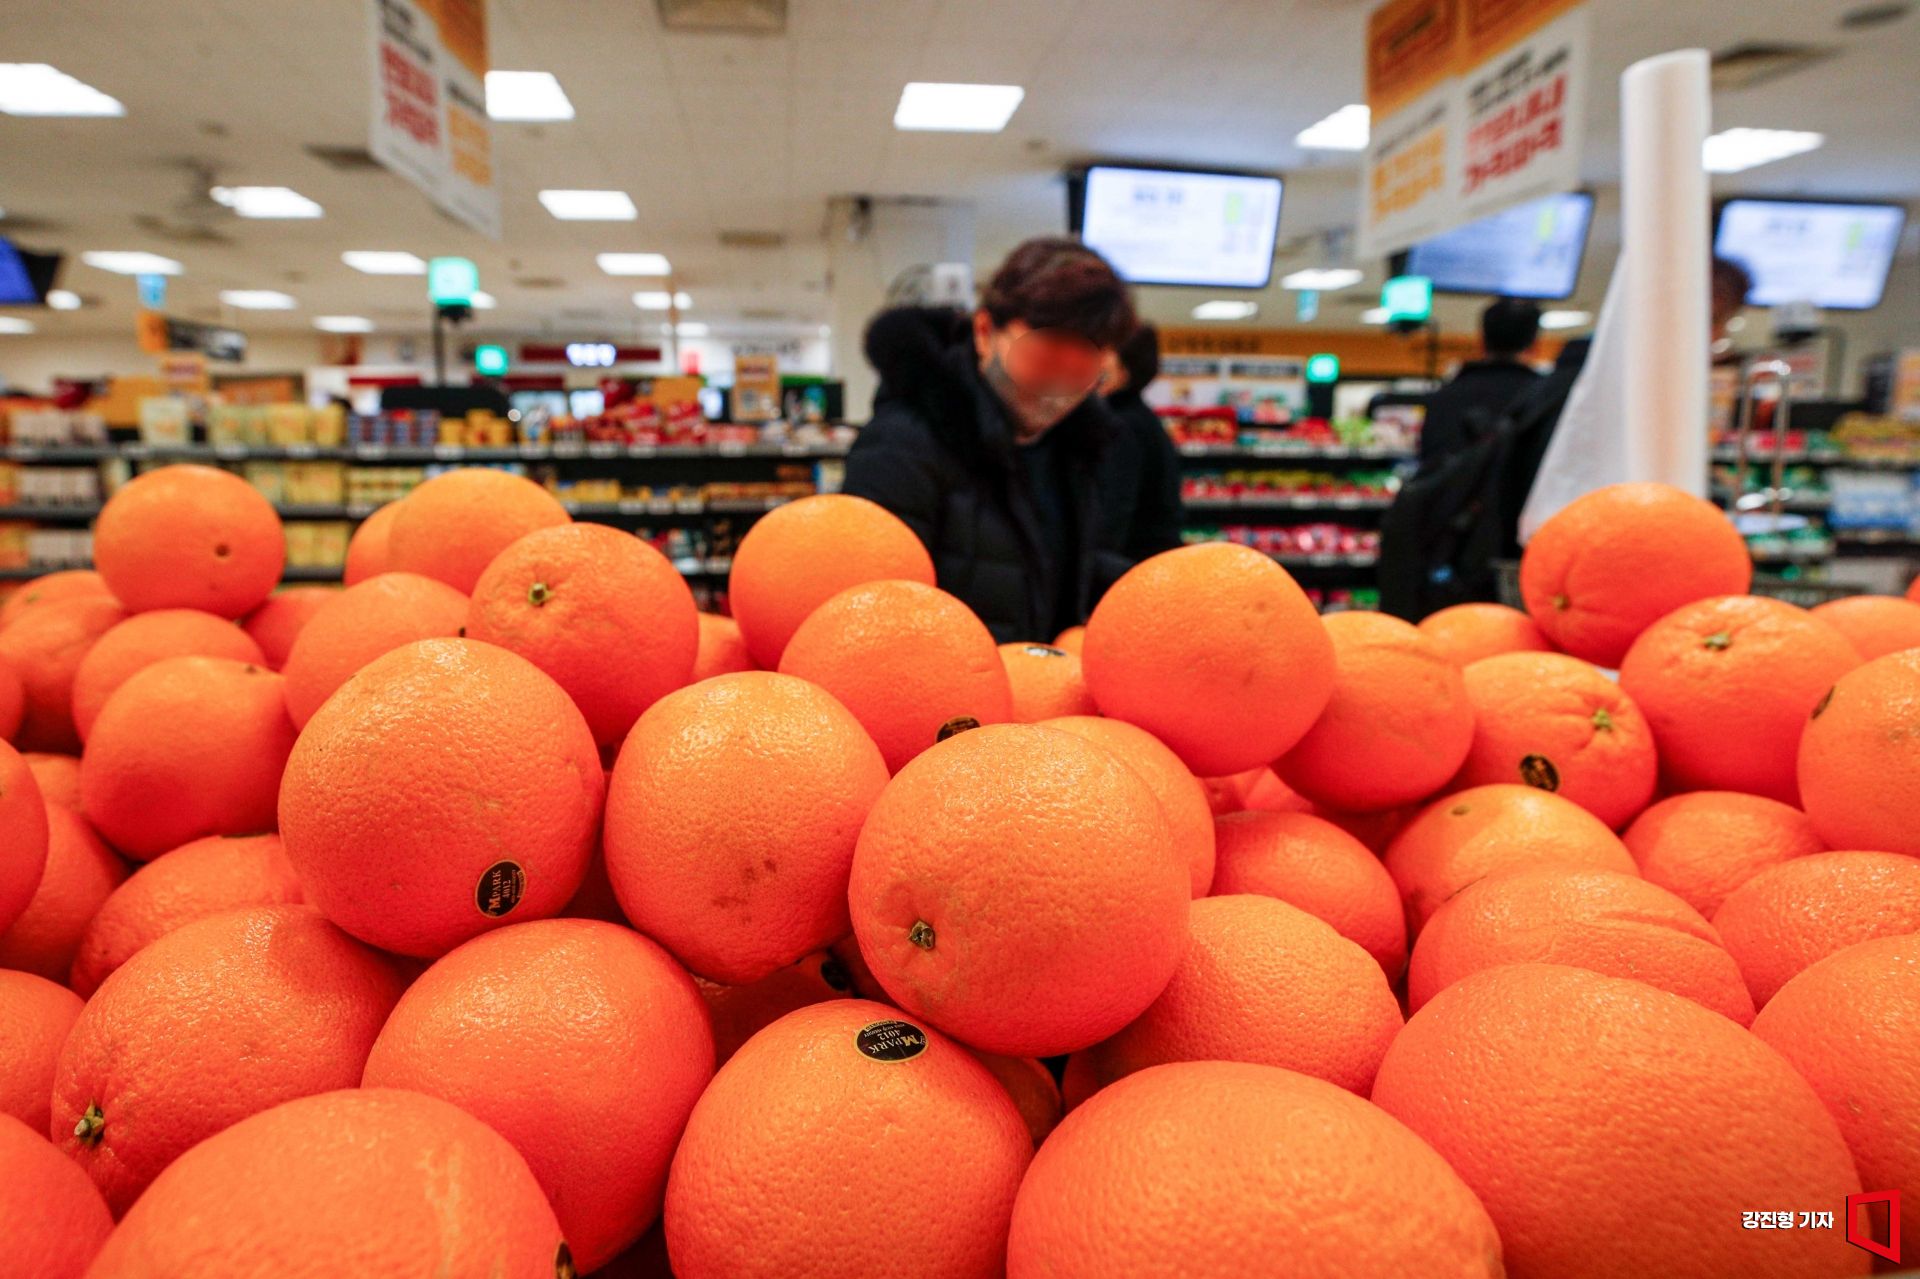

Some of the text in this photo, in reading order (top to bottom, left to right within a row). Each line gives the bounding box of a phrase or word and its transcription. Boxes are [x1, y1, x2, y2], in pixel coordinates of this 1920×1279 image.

[502, 879, 511, 898] 4012
[868, 1034, 919, 1053] MPARK
[877, 1029, 901, 1040] 4012
